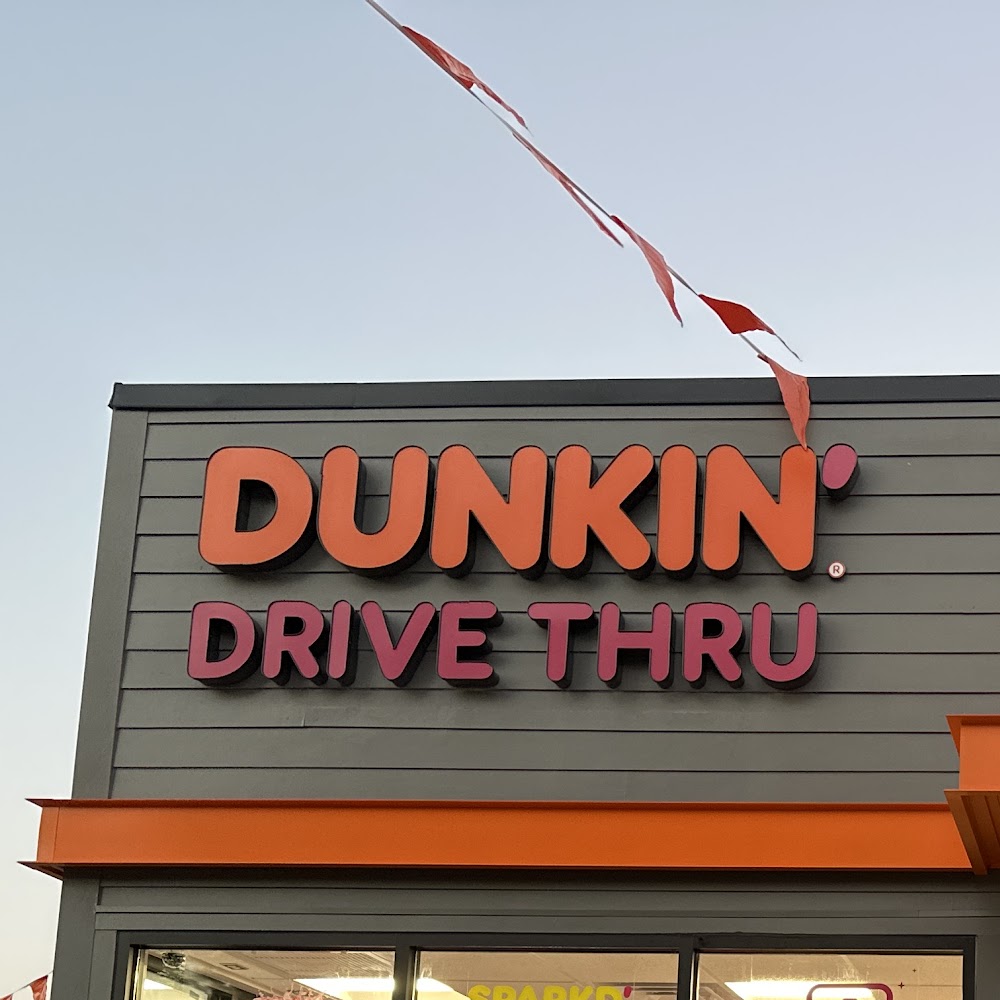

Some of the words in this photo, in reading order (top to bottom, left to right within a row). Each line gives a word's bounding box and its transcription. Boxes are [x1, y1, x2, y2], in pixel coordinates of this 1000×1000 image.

[198, 443, 860, 578] DUNKIN'
[187, 600, 502, 688] DRIVE
[527, 601, 820, 690] THRU
